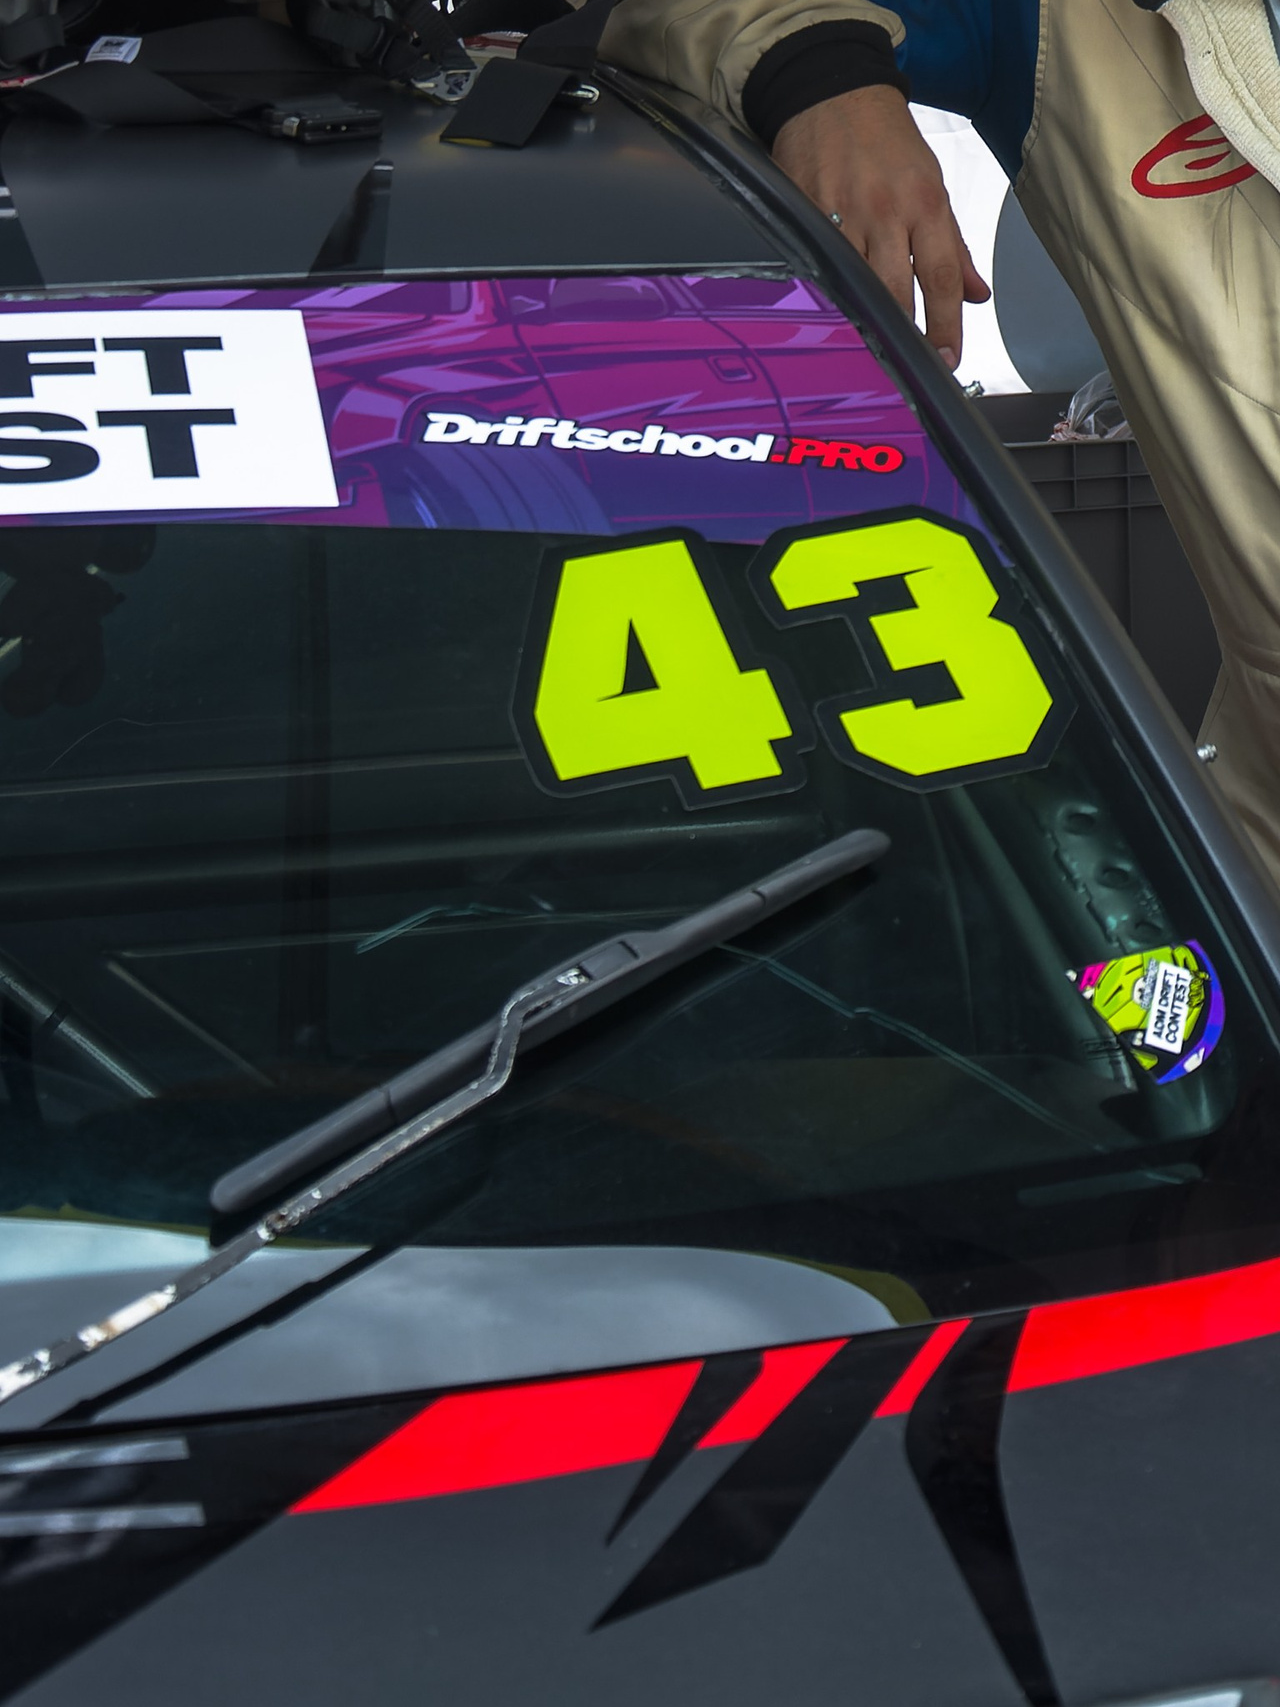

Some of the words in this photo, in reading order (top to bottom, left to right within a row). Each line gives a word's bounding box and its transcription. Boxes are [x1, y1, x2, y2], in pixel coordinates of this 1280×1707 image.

[422, 411, 905, 474] Driftschool.PRO
[533, 517, 1054, 790] 43
[1161, 969, 1177, 1008] DRIFT
[1165, 973, 1191, 1044] CONTEST
